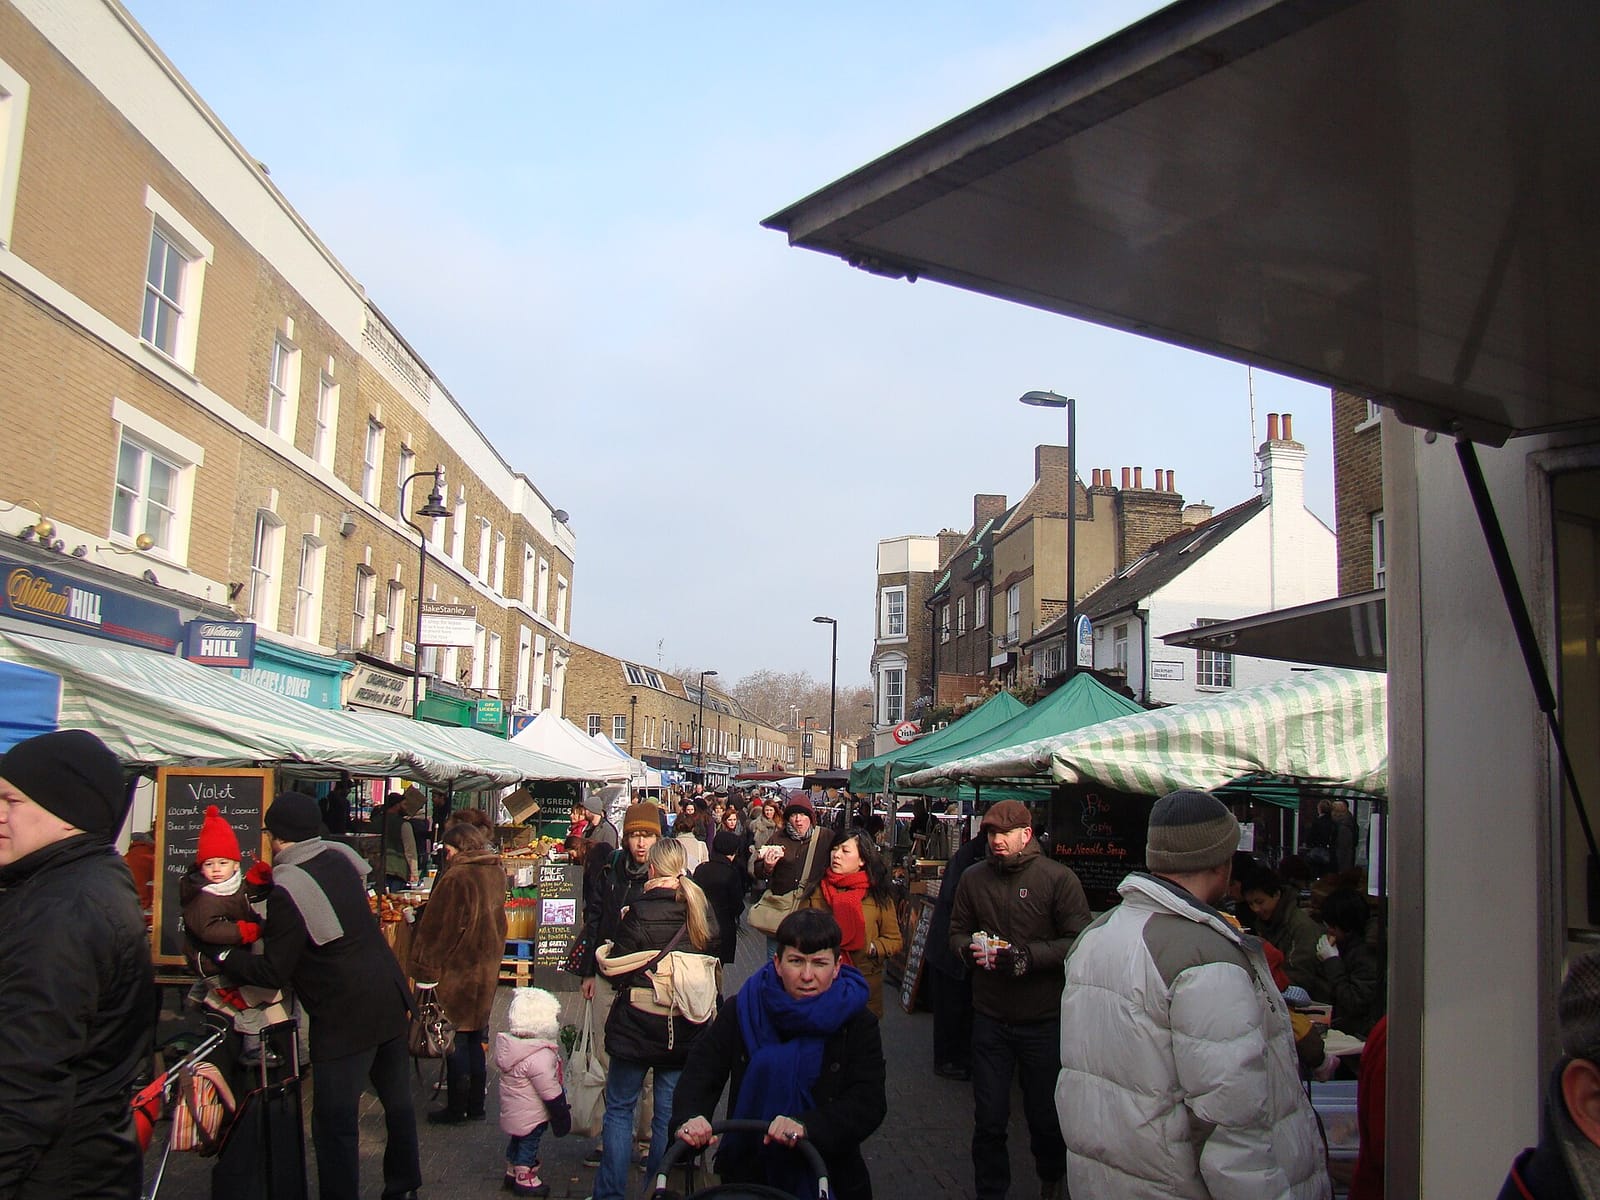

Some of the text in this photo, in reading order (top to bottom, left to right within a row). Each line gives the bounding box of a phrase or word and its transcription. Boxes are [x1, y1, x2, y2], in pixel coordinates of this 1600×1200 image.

[8, 568, 102, 625] William HILL
[421, 604, 467, 616] BlakeStanley
[200, 623, 244, 640] William
[200, 639, 239, 658] HILL
[285, 675, 311, 699] BIKES
[188, 783, 236, 800] Violet
[546, 797, 574, 806] GREEN
[541, 806, 573, 815] GANICS
[1055, 841, 1127, 860] Pho Noodle Soup
